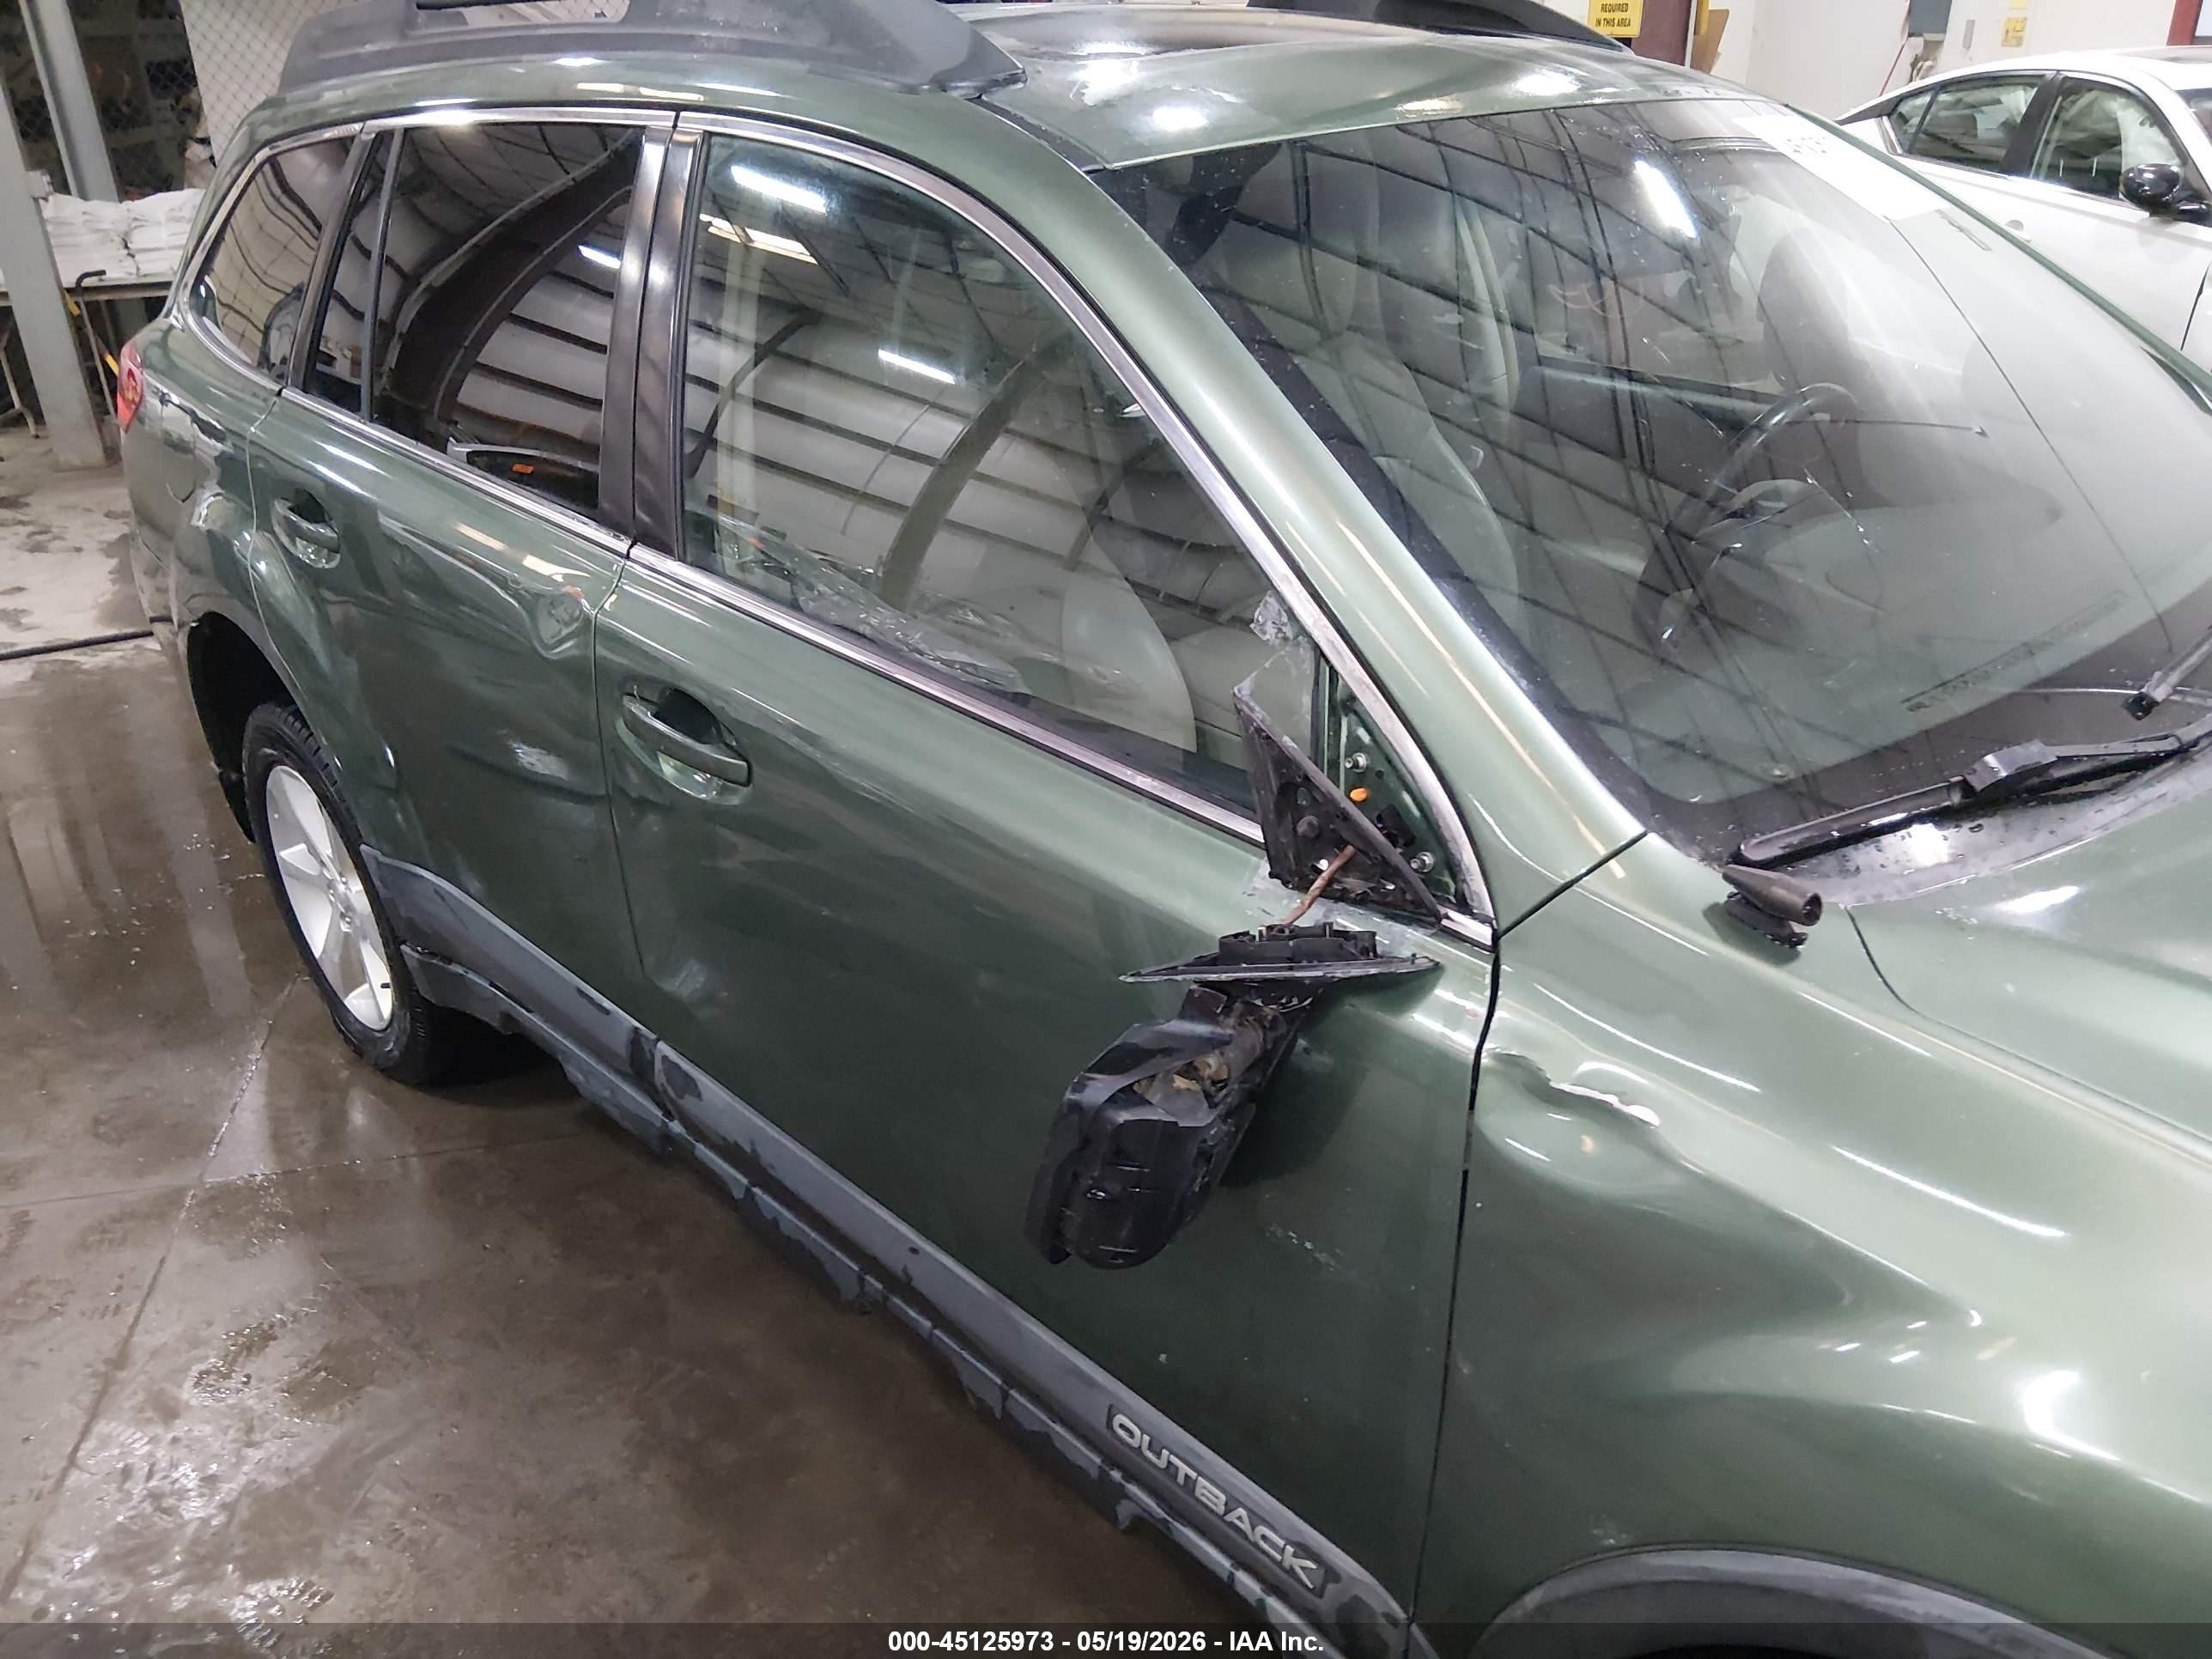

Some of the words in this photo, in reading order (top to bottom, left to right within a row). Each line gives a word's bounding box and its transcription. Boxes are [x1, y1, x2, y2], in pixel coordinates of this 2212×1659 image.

[1601, 3, 1629, 13] REQUIRED
[1595, 18, 1601, 27] IN
[1603, 17, 1615, 27] THIS
[1616, 17, 1631, 27] AREA
[1112, 1413, 1318, 1589] OUTBACK
